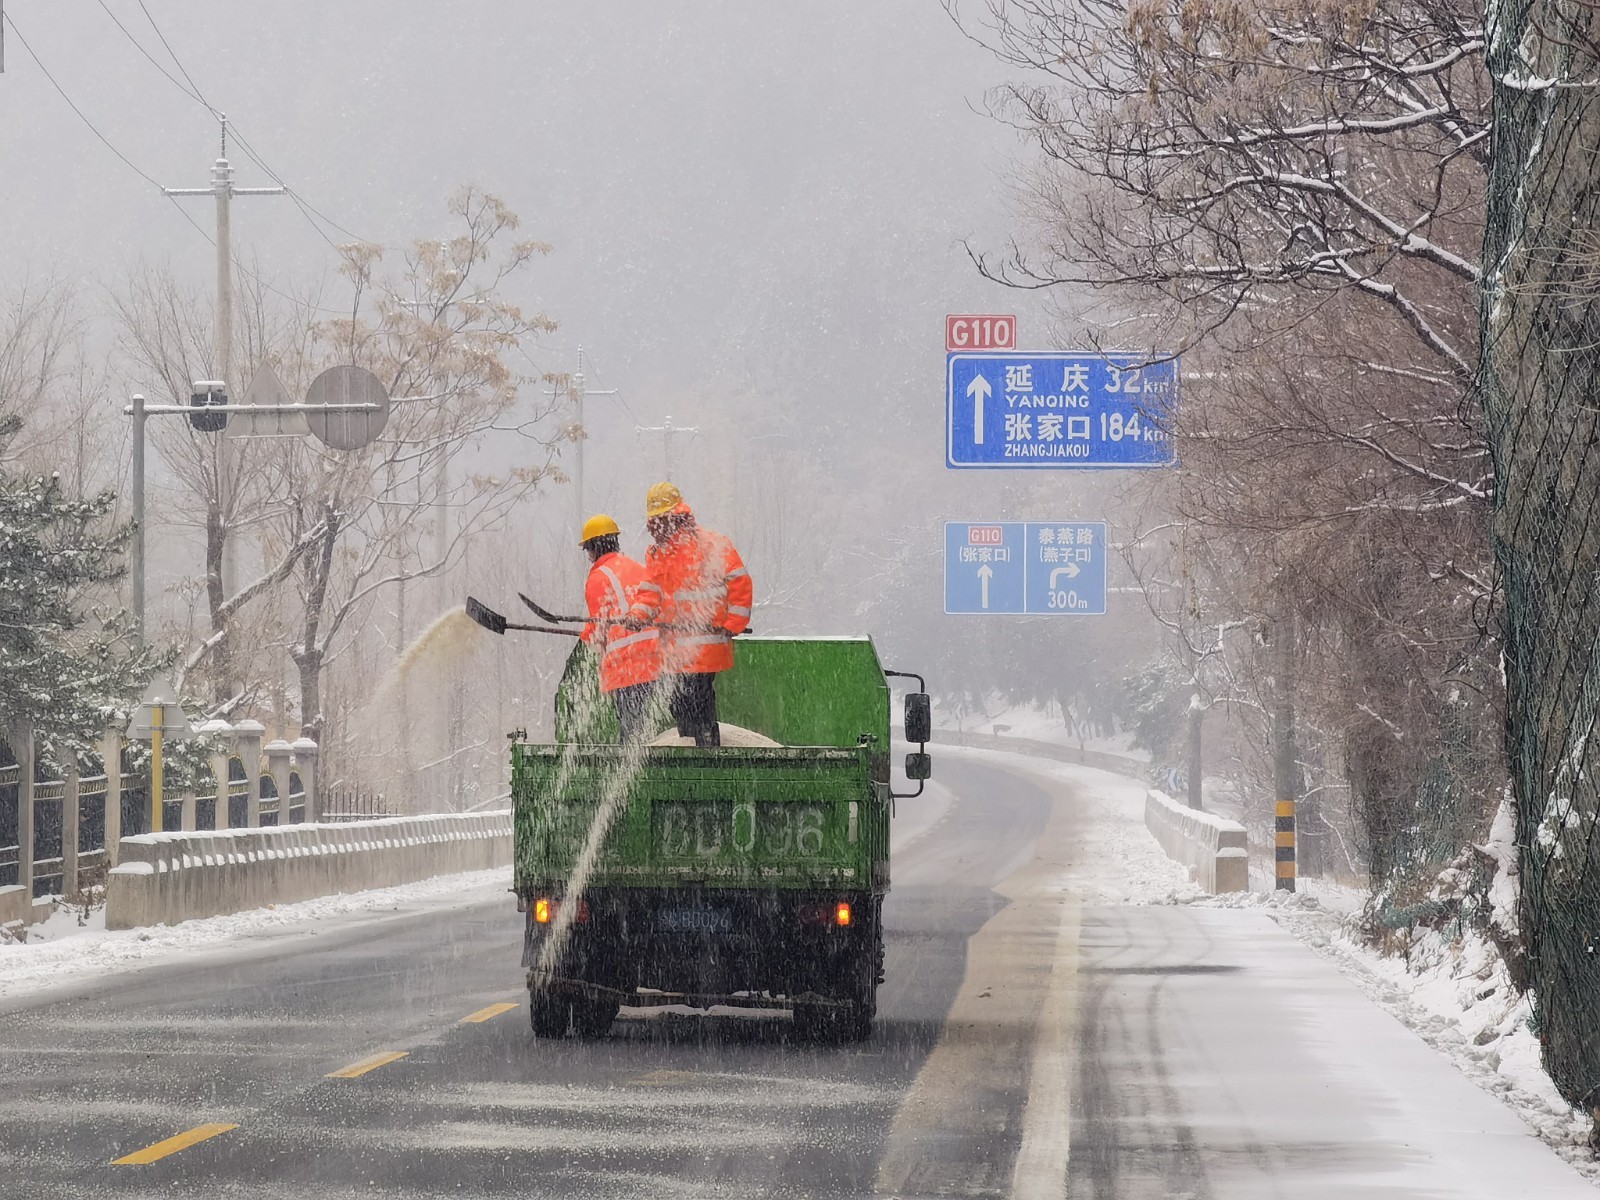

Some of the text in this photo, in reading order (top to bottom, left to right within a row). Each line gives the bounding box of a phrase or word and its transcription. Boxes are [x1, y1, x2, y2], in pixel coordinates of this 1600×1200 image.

[952, 320, 1010, 346] G110
[1005, 395, 1089, 408] YANQING
[1005, 413, 1090, 441] 张家口
[1005, 444, 1090, 457] ZHANGJIAKOU
[971, 529, 1000, 542] G110
[1048, 590, 1088, 609] 300m
